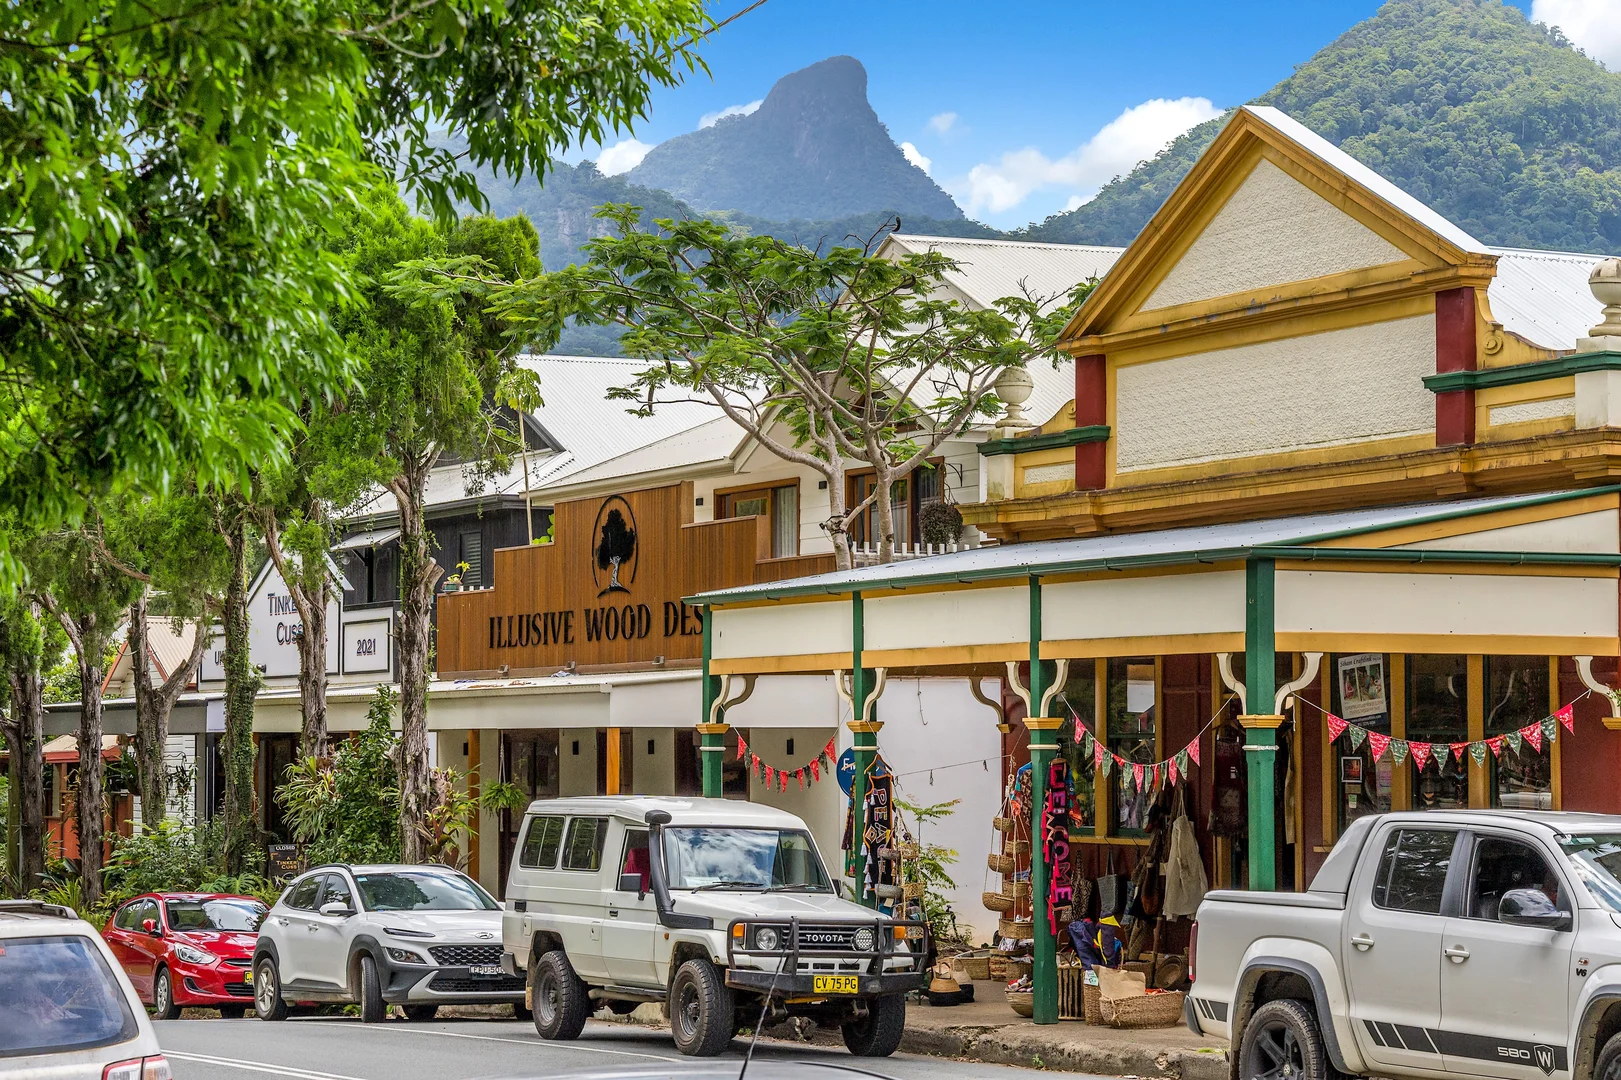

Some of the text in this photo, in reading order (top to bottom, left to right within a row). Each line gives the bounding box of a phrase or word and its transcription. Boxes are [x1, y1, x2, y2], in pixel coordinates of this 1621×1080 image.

[267, 592, 298, 616] TINKE
[488, 601, 704, 649] ILLUSIVE WOOD DES
[356, 638, 377, 657] 2021
[806, 934, 845, 943] TOYOTA
[1575, 968, 1588, 977] V6
[815, 977, 857, 990] CV 75 PG
[1497, 1046, 1551, 1068] 580 W
